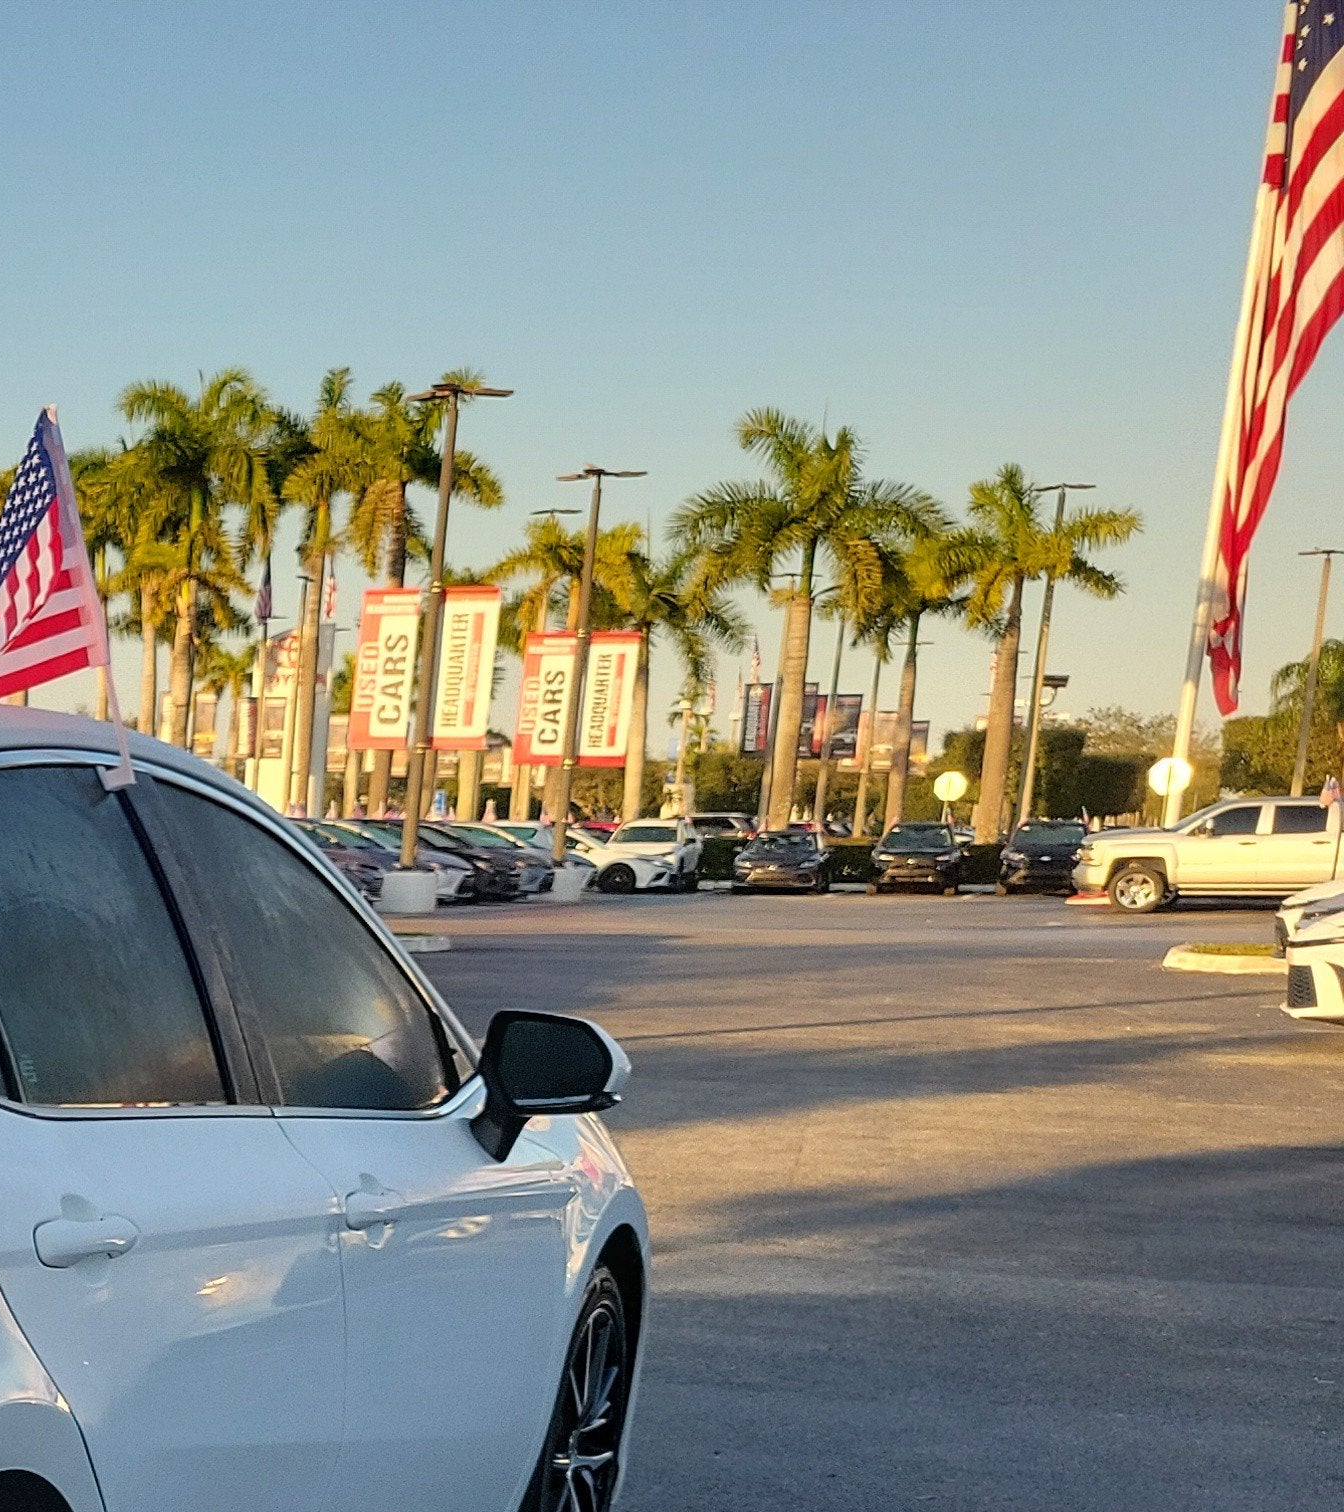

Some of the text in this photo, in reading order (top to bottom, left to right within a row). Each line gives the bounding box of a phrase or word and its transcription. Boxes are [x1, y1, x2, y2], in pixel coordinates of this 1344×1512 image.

[357, 644, 379, 708] USED
[377, 634, 409, 725] CARS
[440, 613, 470, 727] HEADQUARTER
[520, 679, 541, 731] USED
[538, 670, 565, 744] CARS
[587, 653, 613, 748] HEADQUARTER
